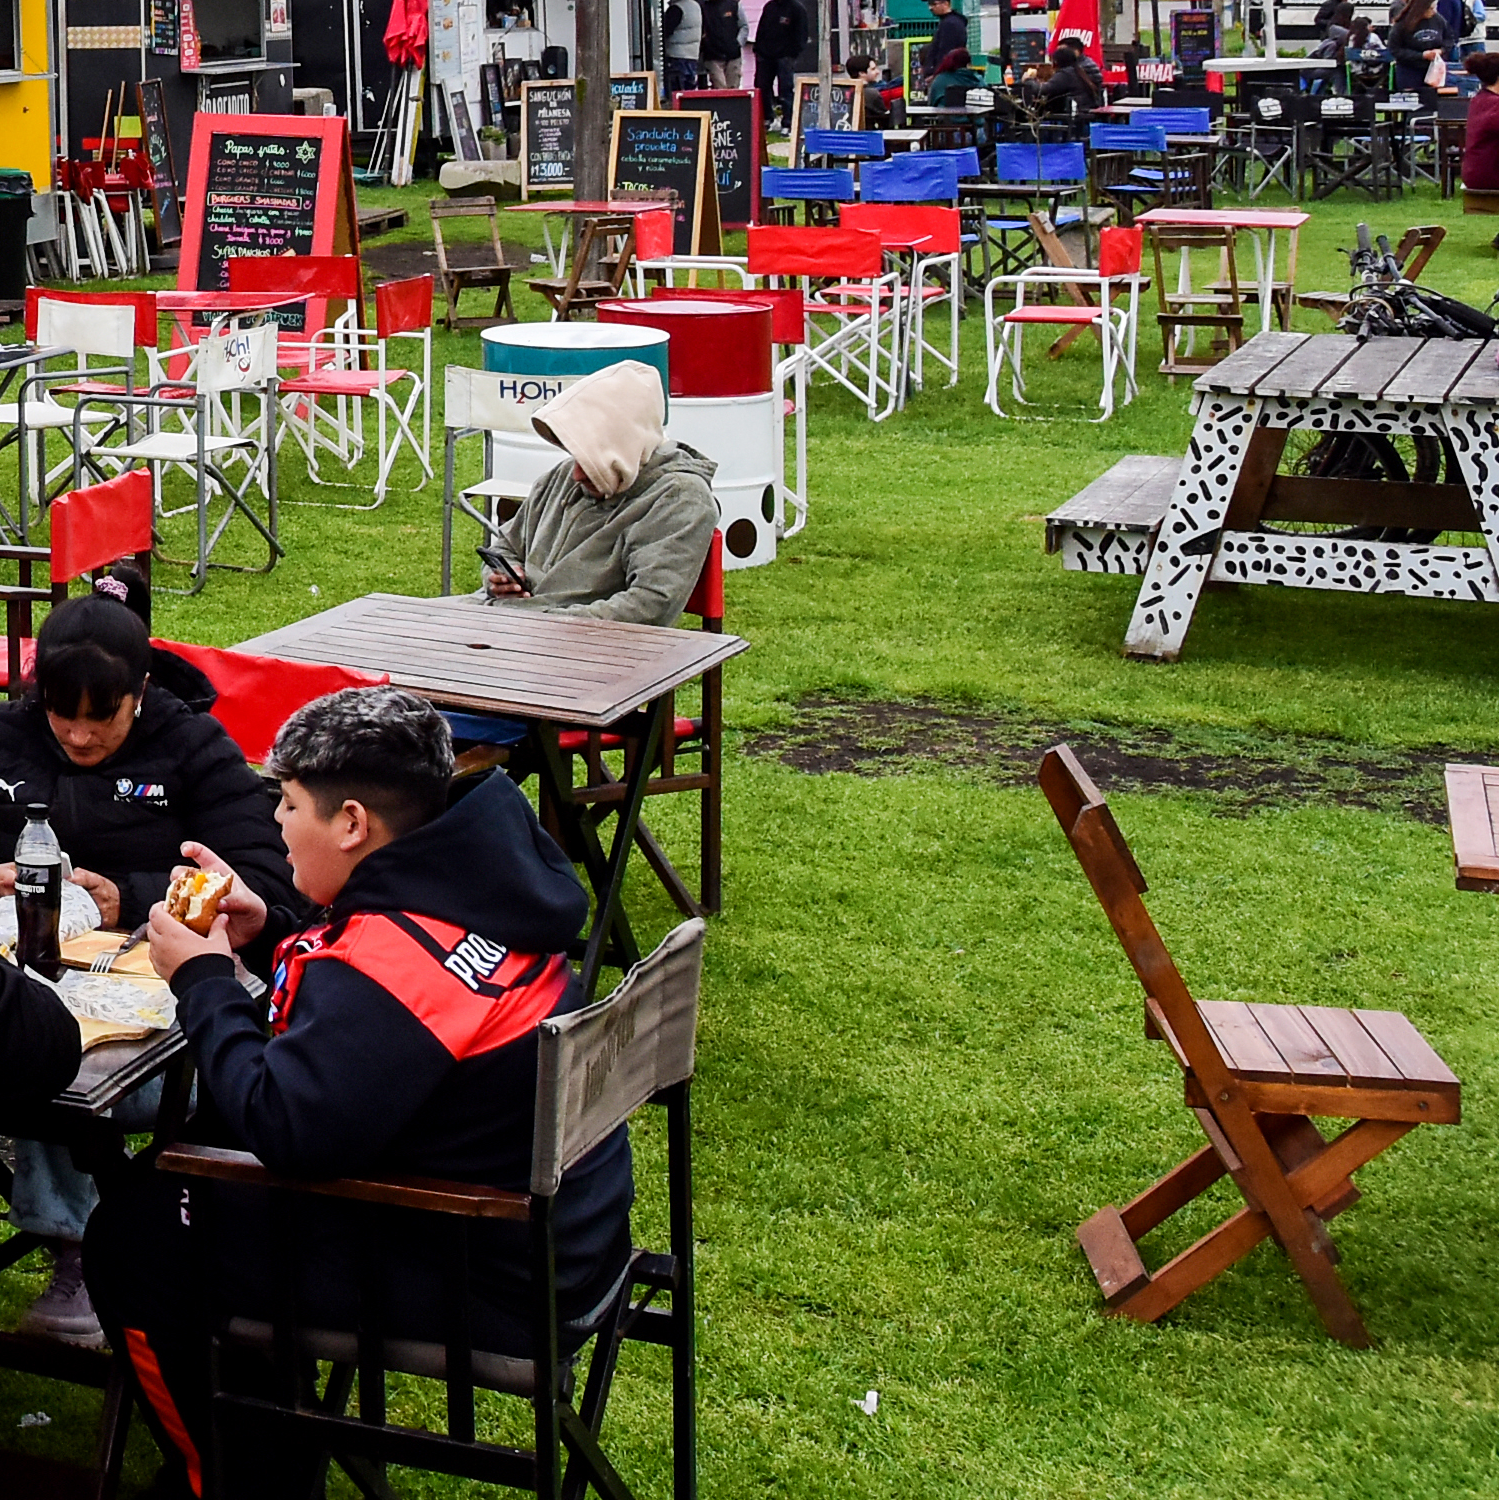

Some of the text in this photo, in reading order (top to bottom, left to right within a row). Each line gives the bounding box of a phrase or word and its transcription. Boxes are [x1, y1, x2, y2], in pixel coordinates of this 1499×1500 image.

[627, 127, 680, 142] Sandwich
[224, 139, 254, 160] Papas
[211, 193, 251, 205] BURGUERS
